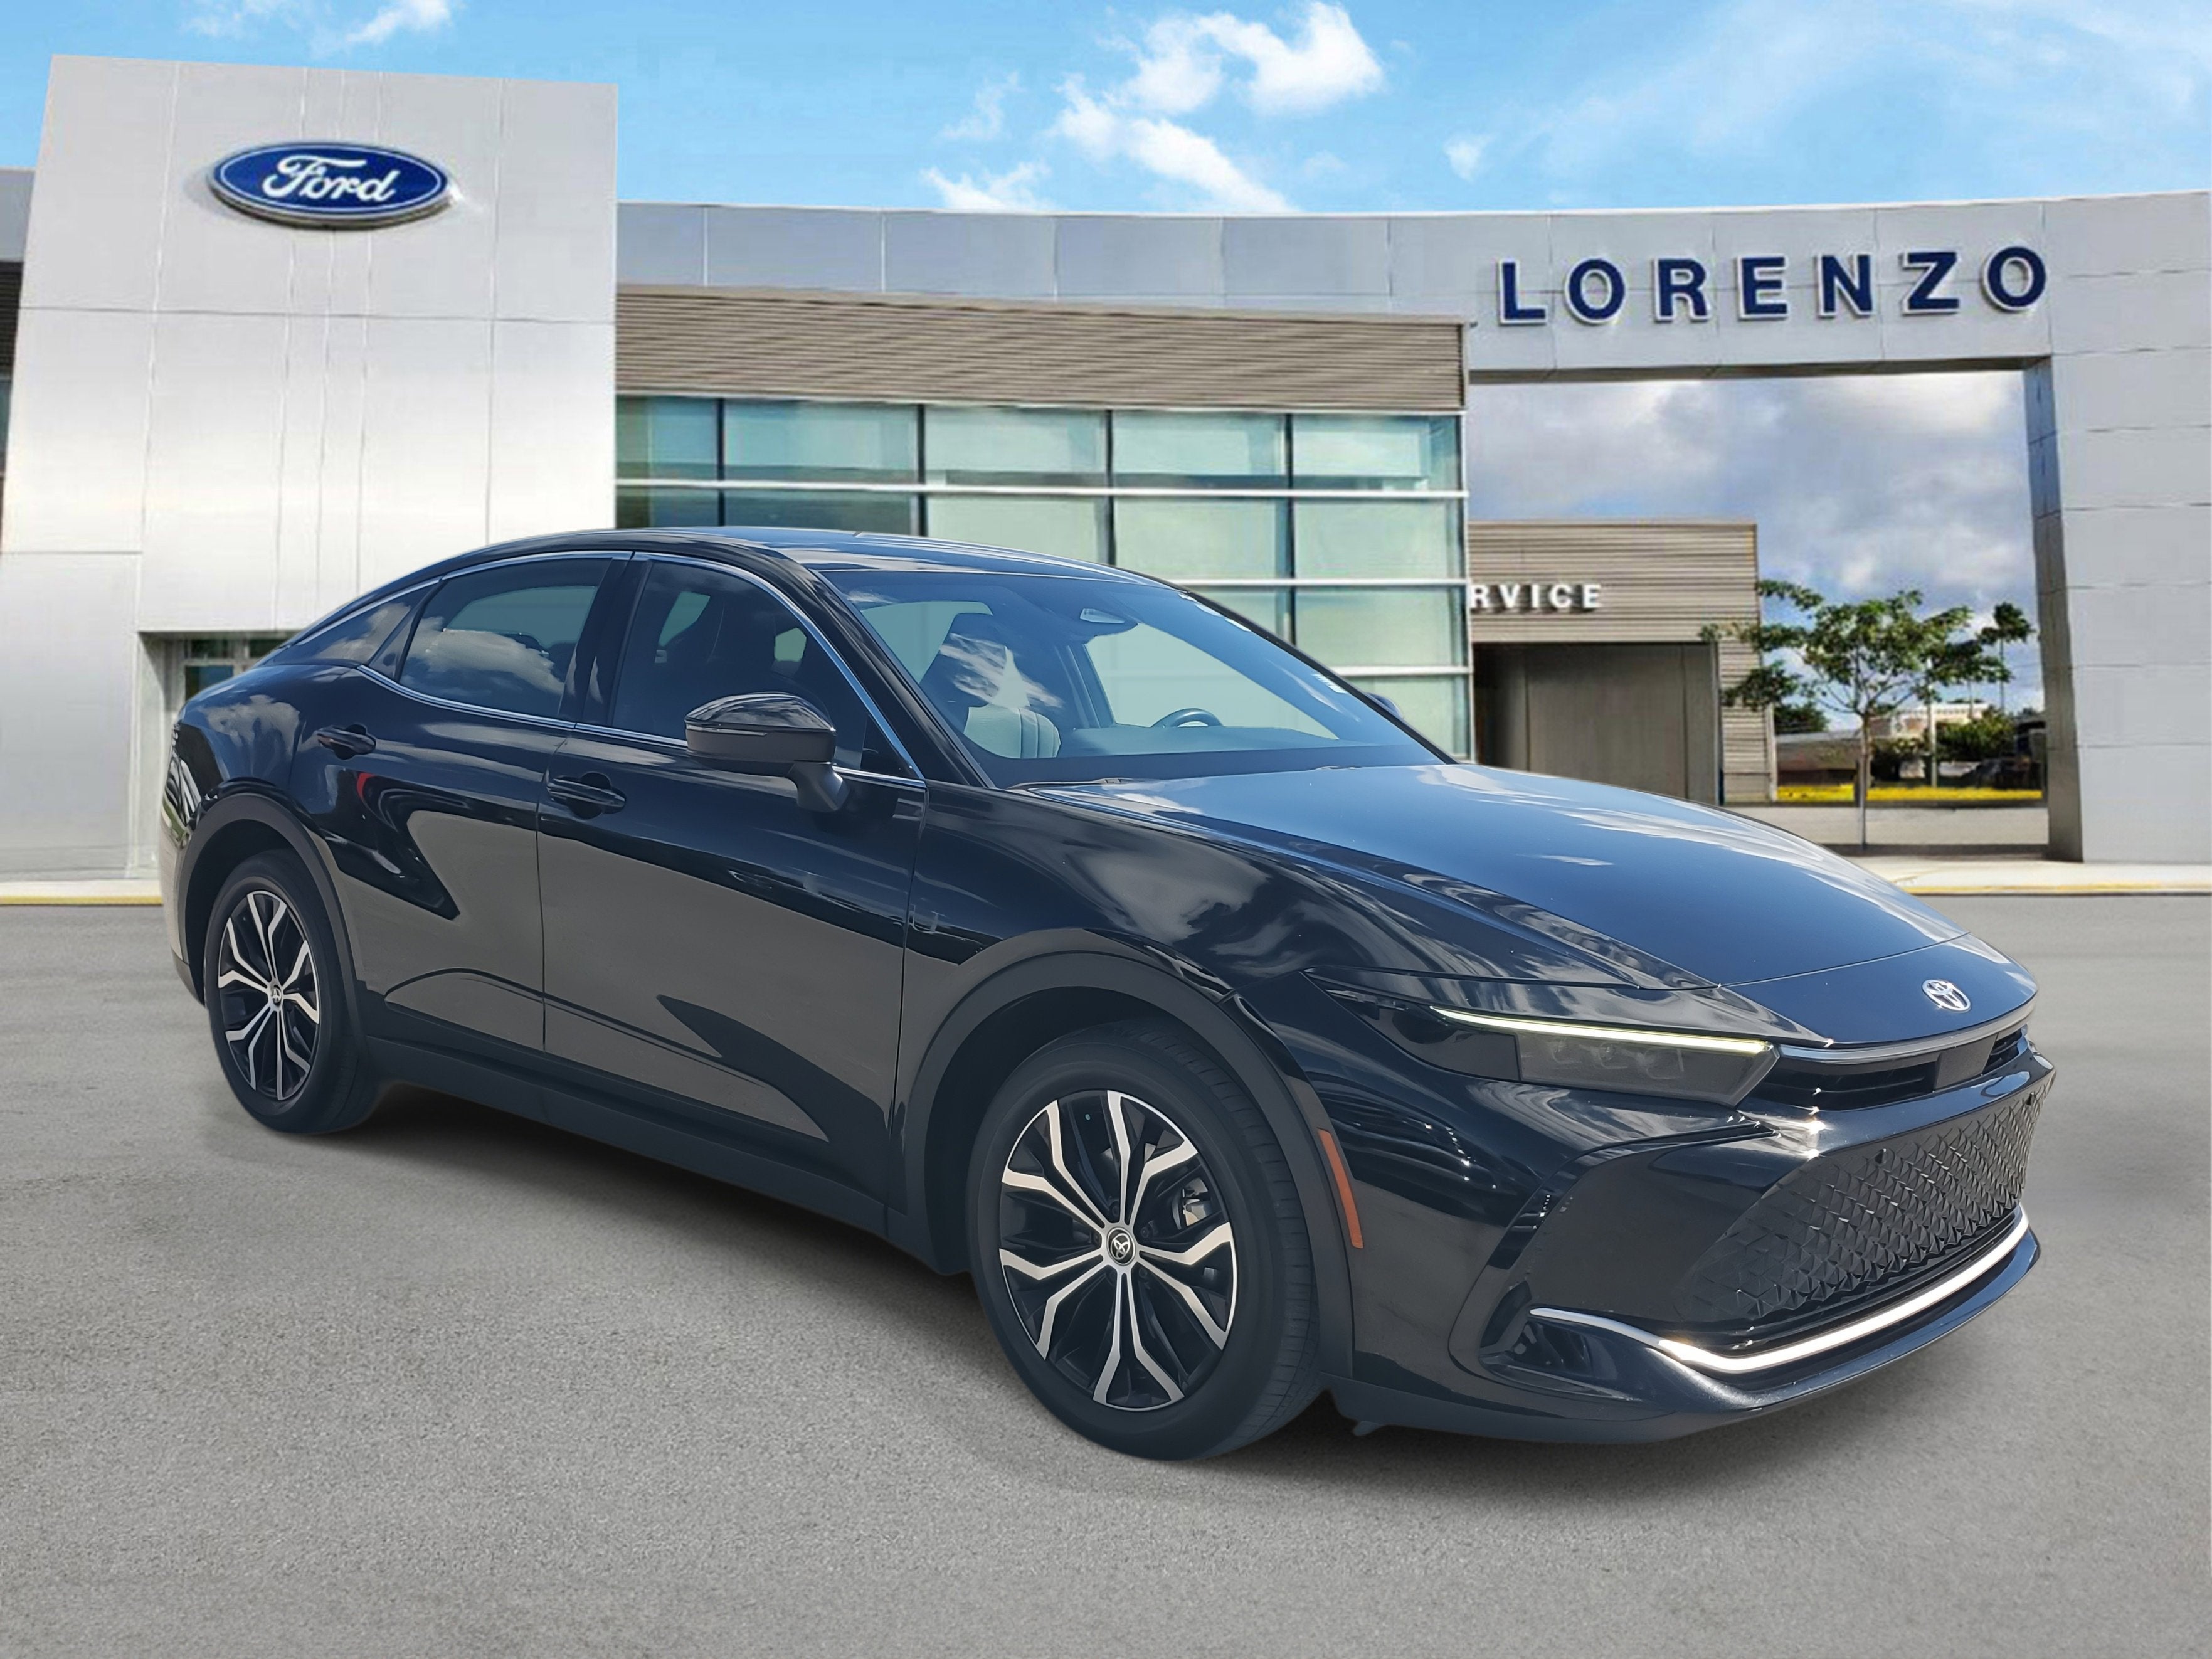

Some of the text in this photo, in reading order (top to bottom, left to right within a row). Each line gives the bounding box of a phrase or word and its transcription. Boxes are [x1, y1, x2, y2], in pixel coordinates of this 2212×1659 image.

[262, 155, 401, 201] Ford
[1496, 246, 2048, 326] LORENZO
[1469, 584, 1601, 608] RVICE
